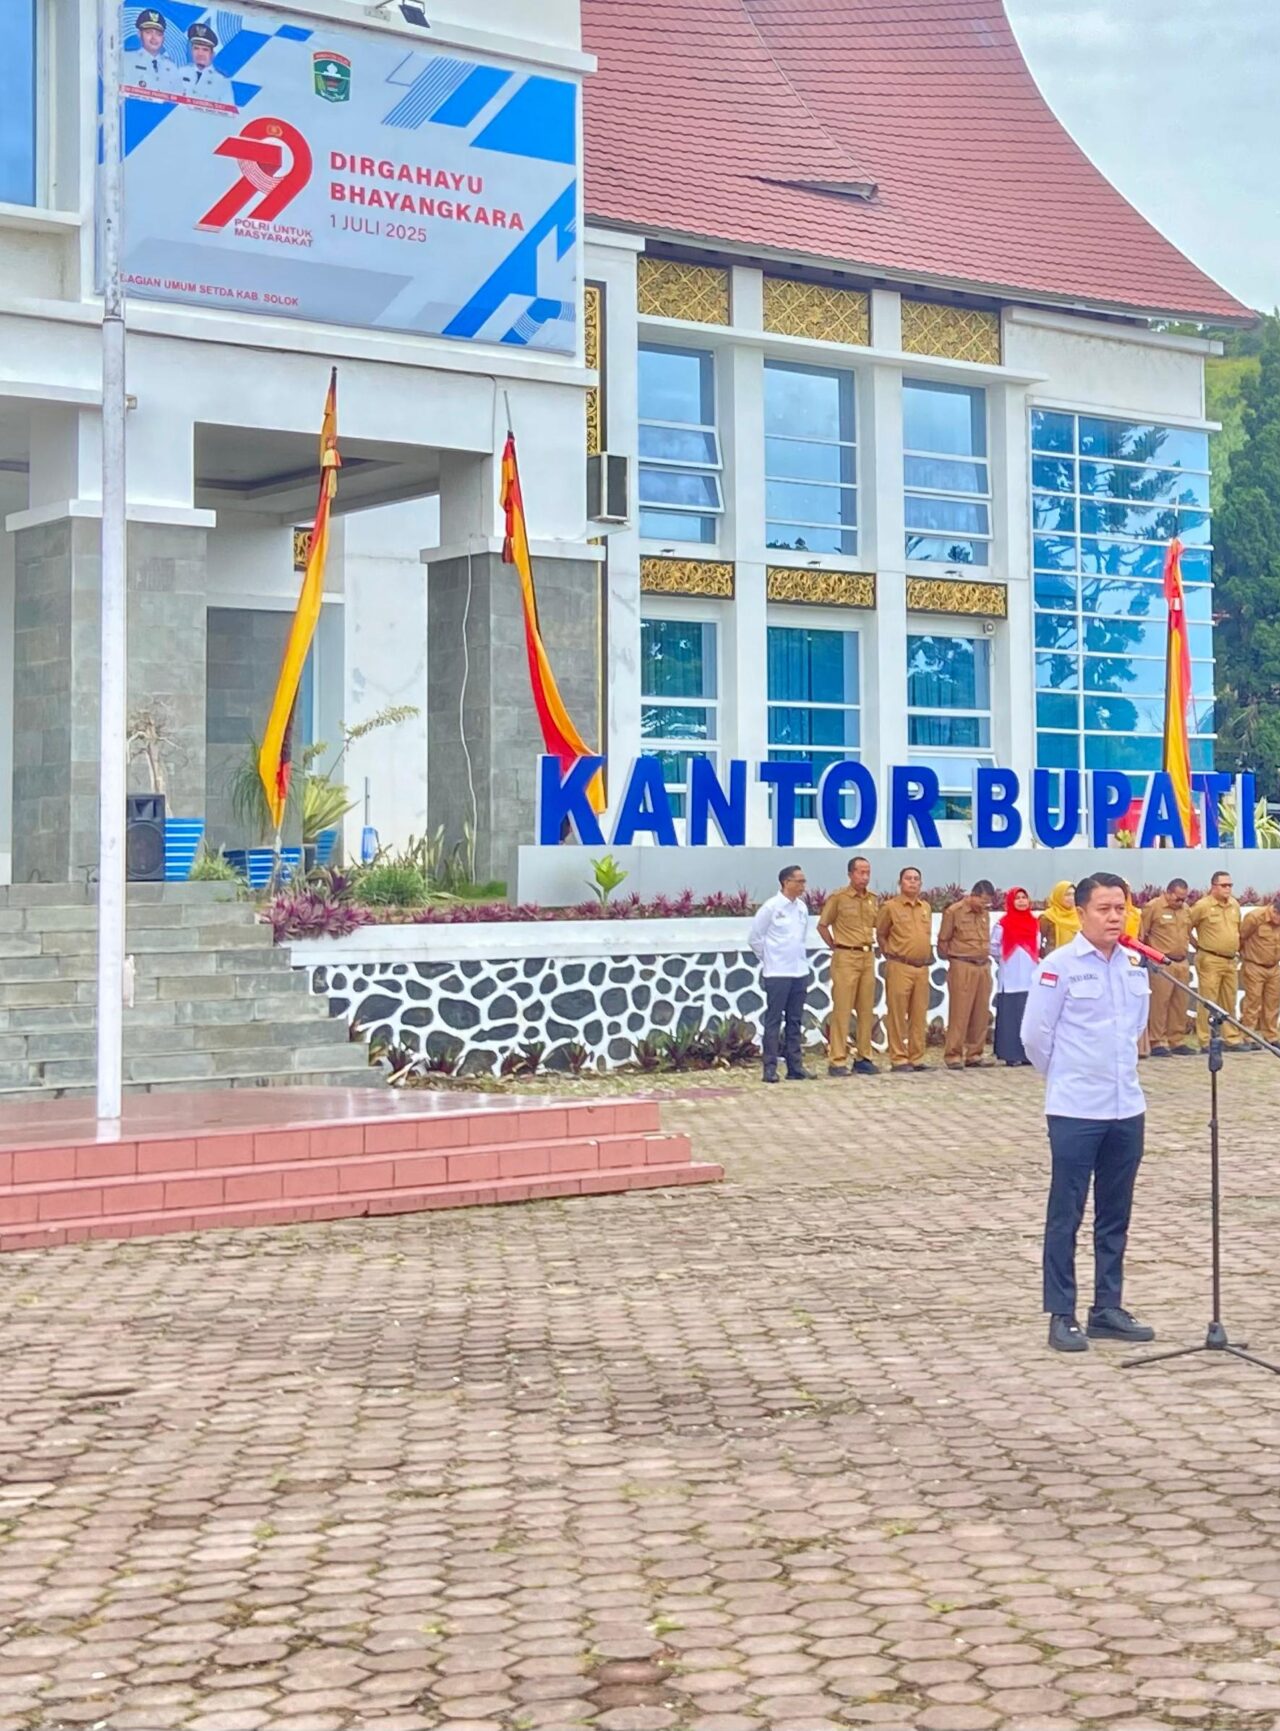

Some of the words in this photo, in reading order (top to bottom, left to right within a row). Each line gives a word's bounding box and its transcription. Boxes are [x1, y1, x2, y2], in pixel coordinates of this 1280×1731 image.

[330, 151, 483, 195] DIRGAHAYU
[330, 182, 525, 231] BHAYANGKARA
[234, 218, 270, 232] POLRI
[273, 224, 312, 238] UNTUK
[234, 228, 314, 248] MASYARAKAT
[330, 214, 336, 228] 1
[342, 215, 380, 236] JULI
[386, 223, 427, 243] 2025
[164, 280, 197, 292] UMUM
[199, 284, 234, 298] SETDA
[263, 293, 299, 306] SOLOK
[536, 754, 943, 848] KANTOR
[972, 767, 1257, 849] BUPATI
